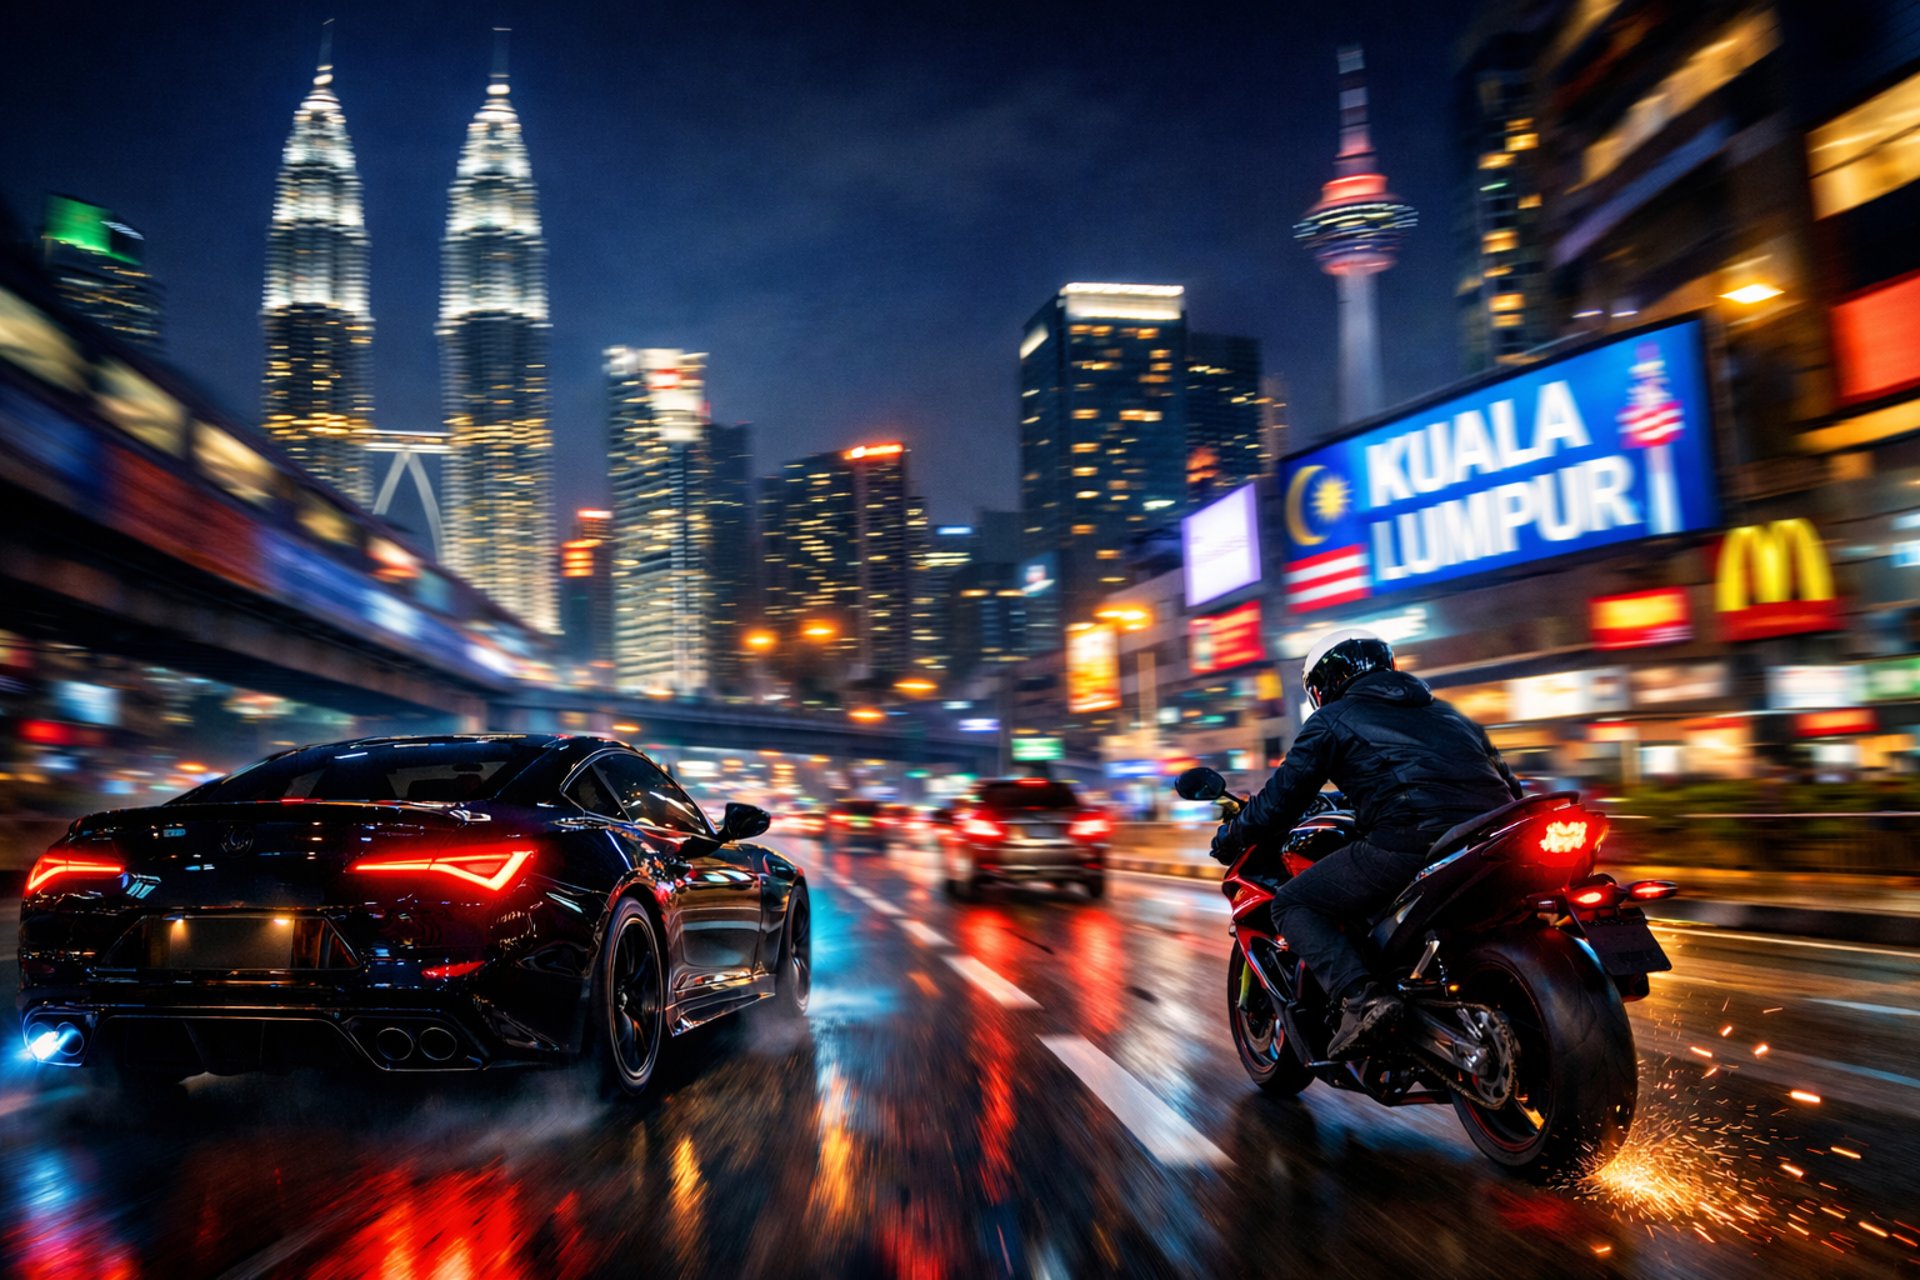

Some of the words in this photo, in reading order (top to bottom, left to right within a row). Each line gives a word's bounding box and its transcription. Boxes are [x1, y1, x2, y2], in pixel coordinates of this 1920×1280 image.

[1366, 381, 1592, 507] KUALA
[1371, 455, 1642, 581] LUMPUR
[1716, 518, 1834, 611] M
